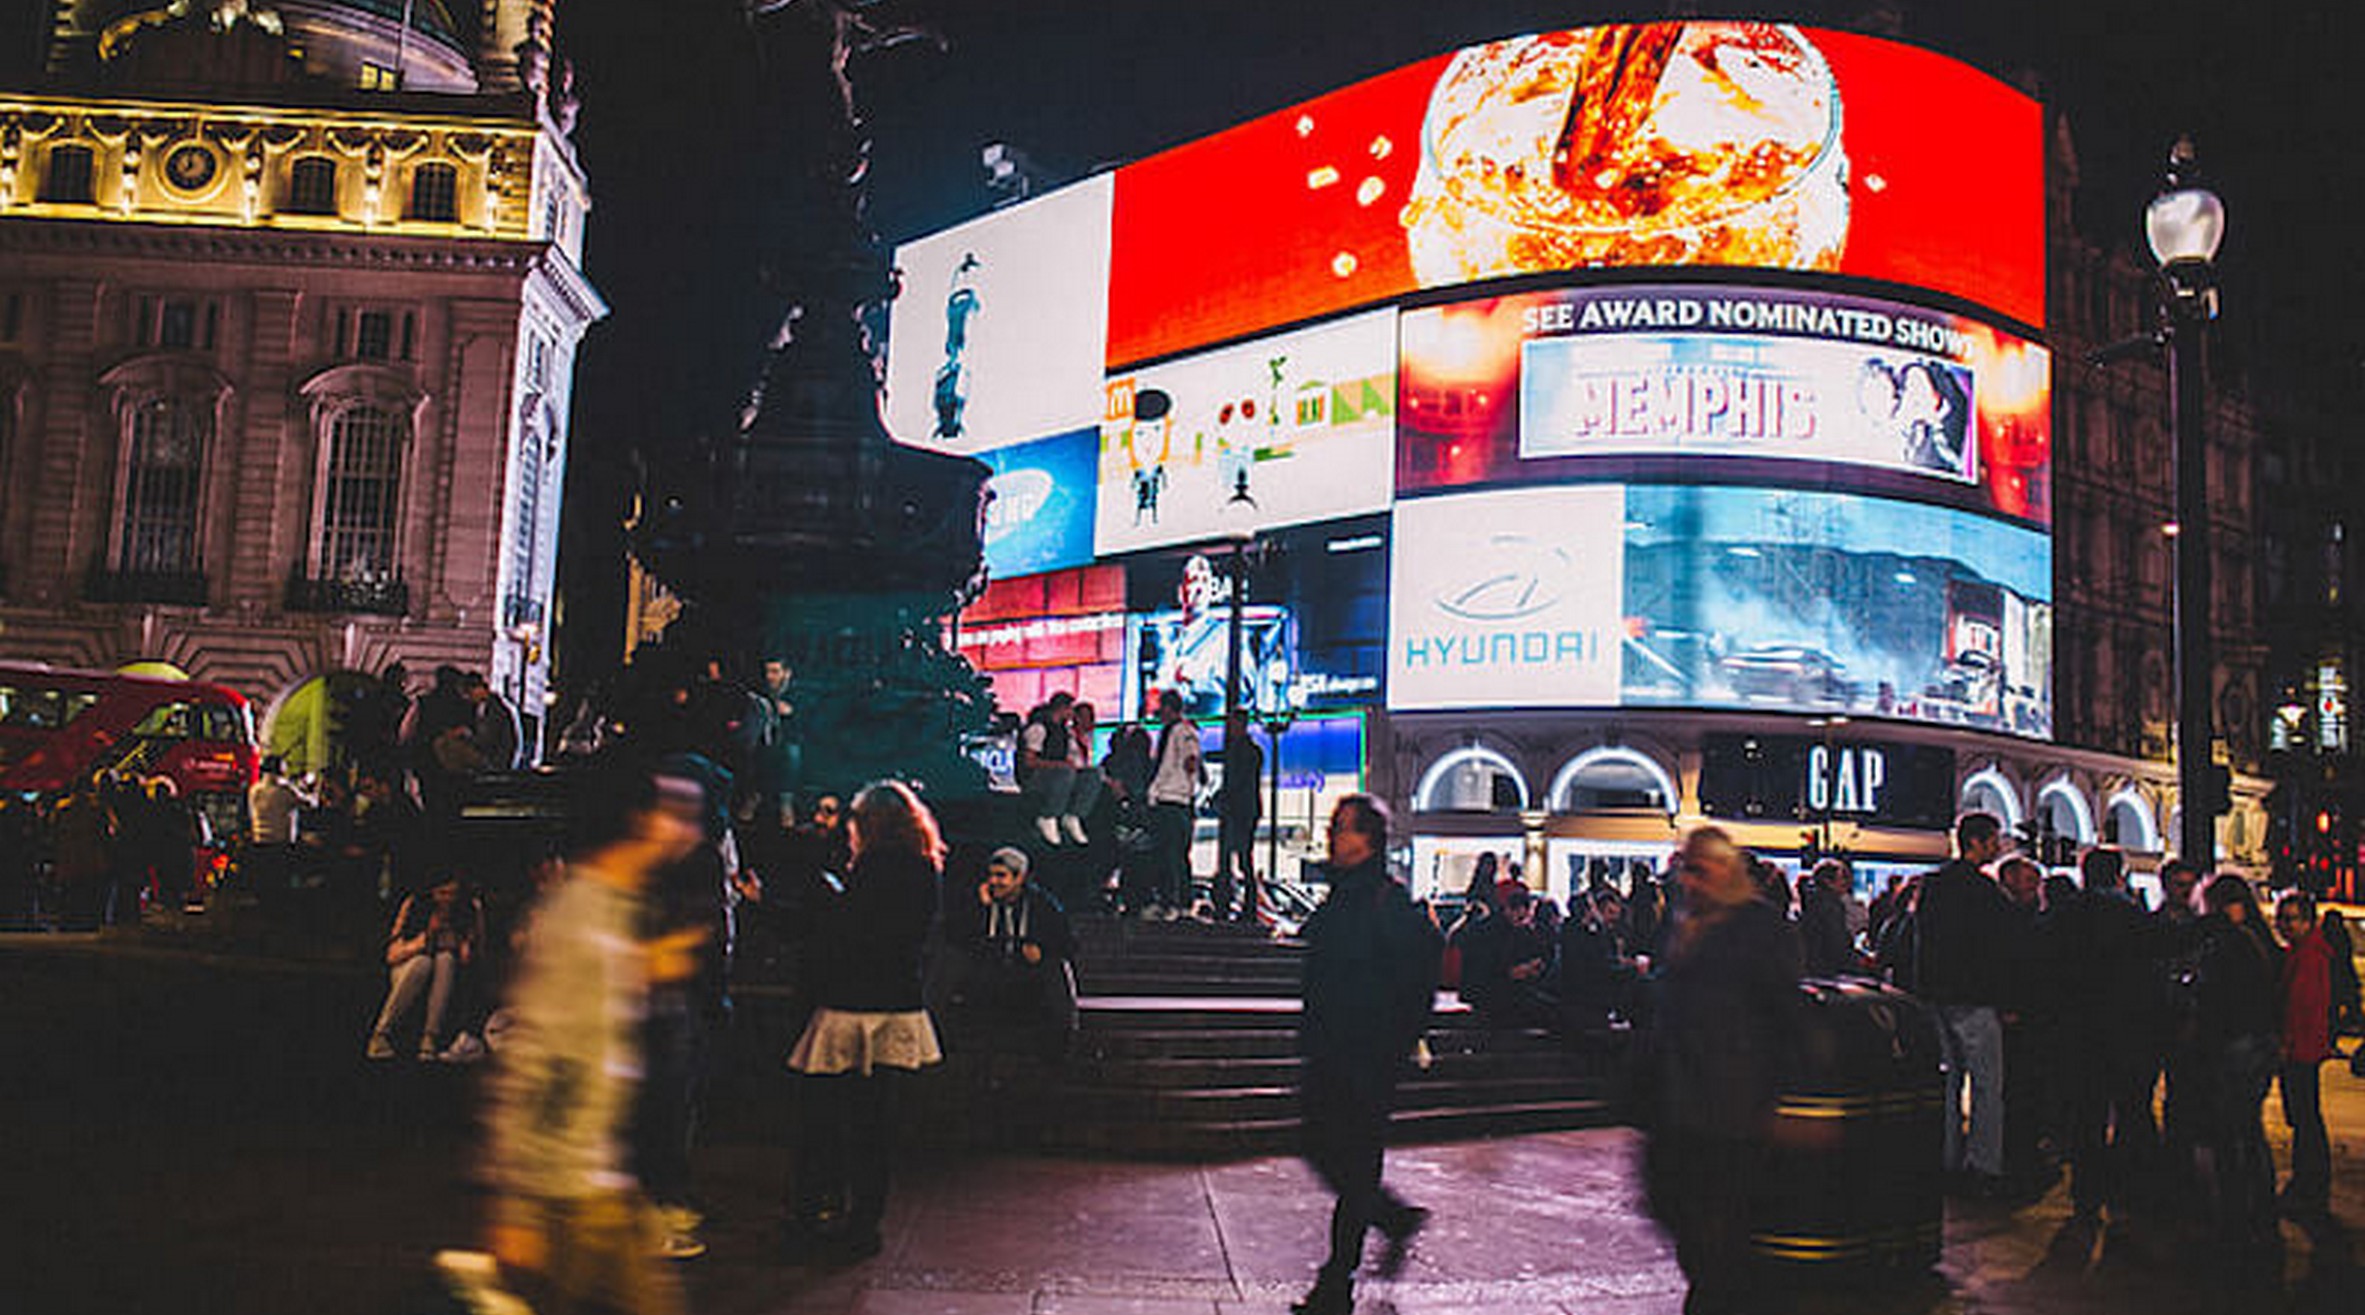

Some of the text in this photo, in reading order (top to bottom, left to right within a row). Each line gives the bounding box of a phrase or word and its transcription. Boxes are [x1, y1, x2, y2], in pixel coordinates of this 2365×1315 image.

[1523, 304, 1574, 333] SEE
[1580, 300, 1702, 329] AWARD
[1709, 300, 1893, 341] NOMINATED
[1575, 377, 1817, 438] MEMPHIS
[1406, 629, 1598, 668] HYUNDAI
[1809, 745, 1884, 812] GAP
